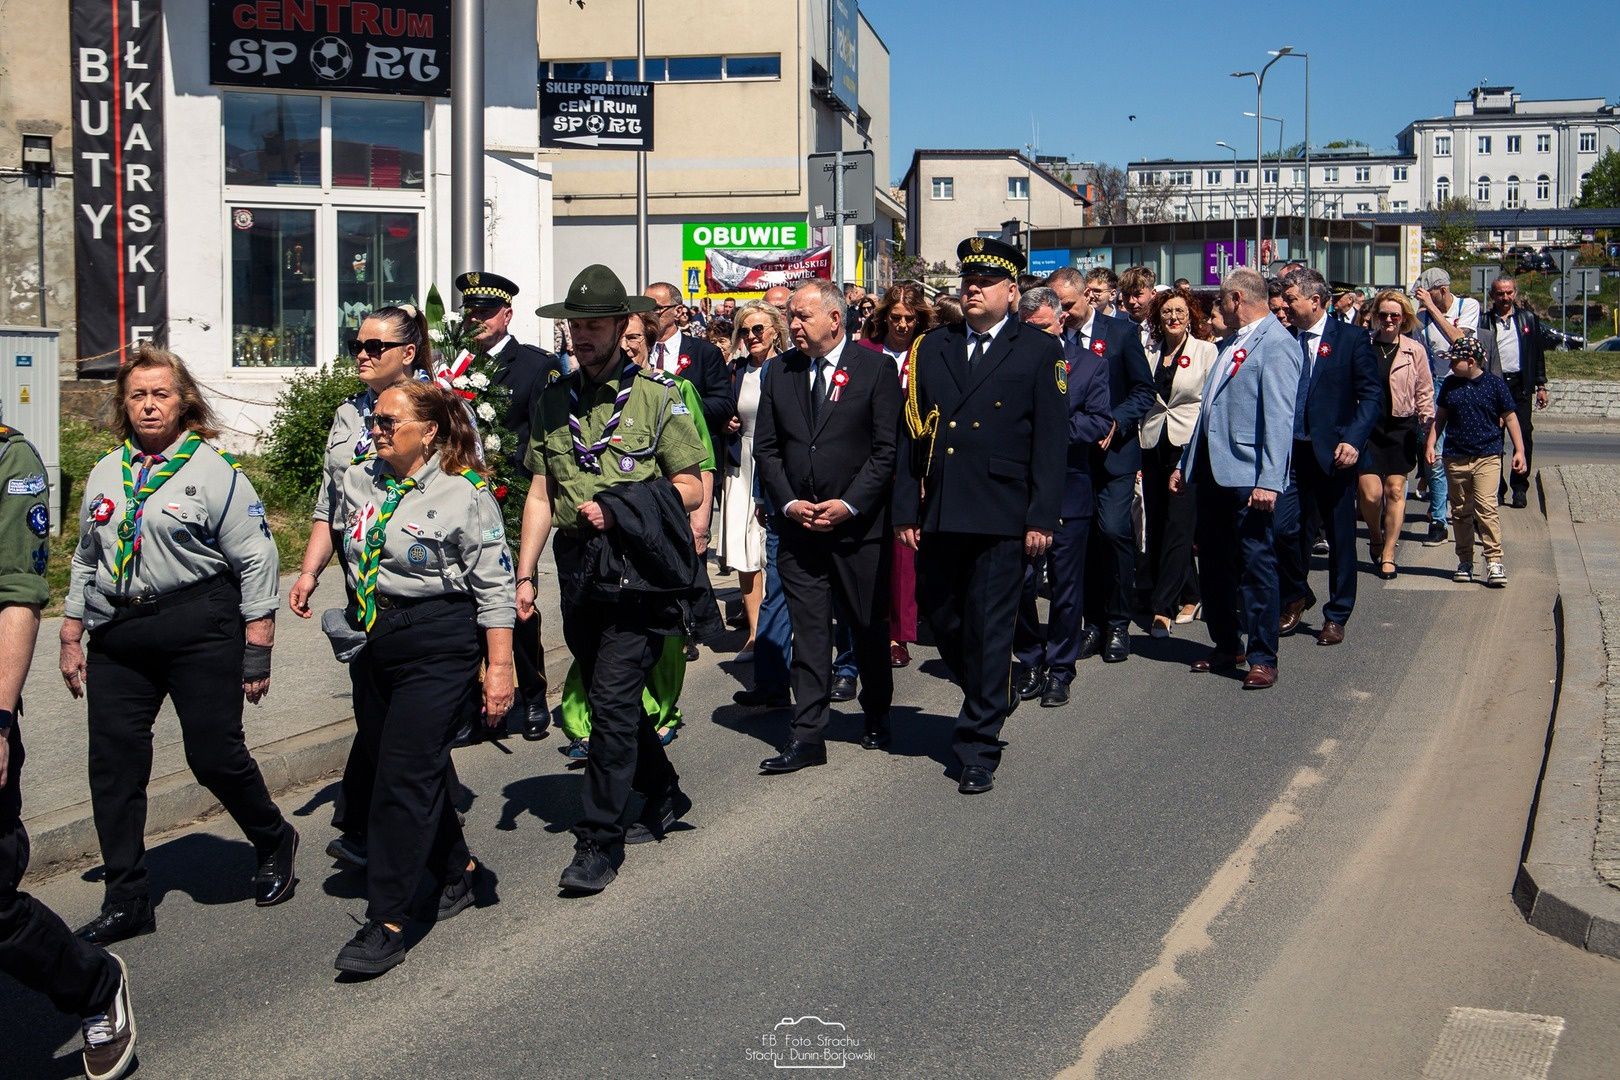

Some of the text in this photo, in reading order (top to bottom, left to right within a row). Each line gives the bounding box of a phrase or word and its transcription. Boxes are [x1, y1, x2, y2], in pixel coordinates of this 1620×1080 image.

[232, 0, 434, 39] CENTRUM
[546, 82, 649, 96] SKLEP SPORTOWY
[559, 96, 637, 114] CENTRUM
[78, 47, 113, 240] BUTY
[693, 226, 797, 246] OBUWIE
[755, 259, 828, 272] AZETY POLSKIEJ
